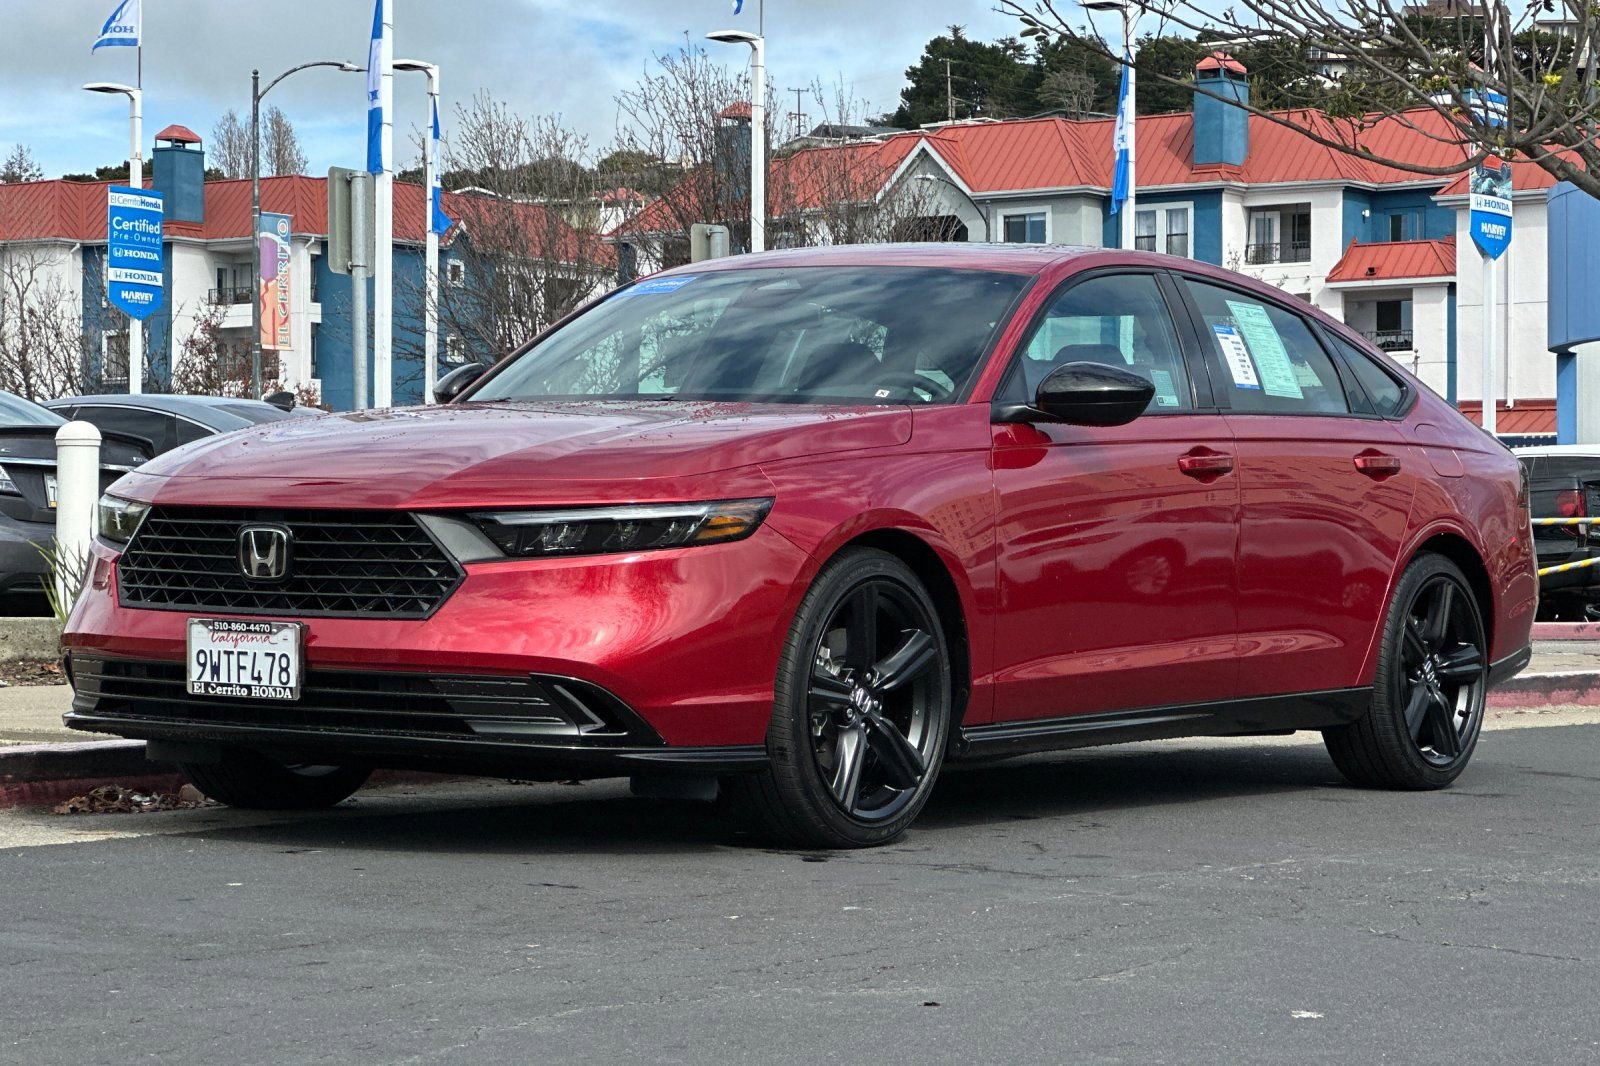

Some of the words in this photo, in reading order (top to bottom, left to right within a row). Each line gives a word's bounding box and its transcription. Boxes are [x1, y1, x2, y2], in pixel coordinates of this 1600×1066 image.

[1484, 199, 1510, 212] HONDA
[112, 216, 160, 234] Certified
[1481, 222, 1506, 236] HARVEY
[113, 231, 160, 244] Pre-Owned
[124, 249, 160, 260] HONDA
[277, 218, 289, 318] CERRITO
[124, 272, 158, 282] HONDA
[121, 290, 154, 302] HARVEY
[278, 324, 289, 345] EL
[214, 621, 270, 632] 510-860-4470
[210, 630, 278, 648] California
[196, 648, 290, 686] 9WTF478
[193, 682, 205, 693] El
[208, 684, 248, 696] Cerrito
[252, 686, 292, 698] HONDA
